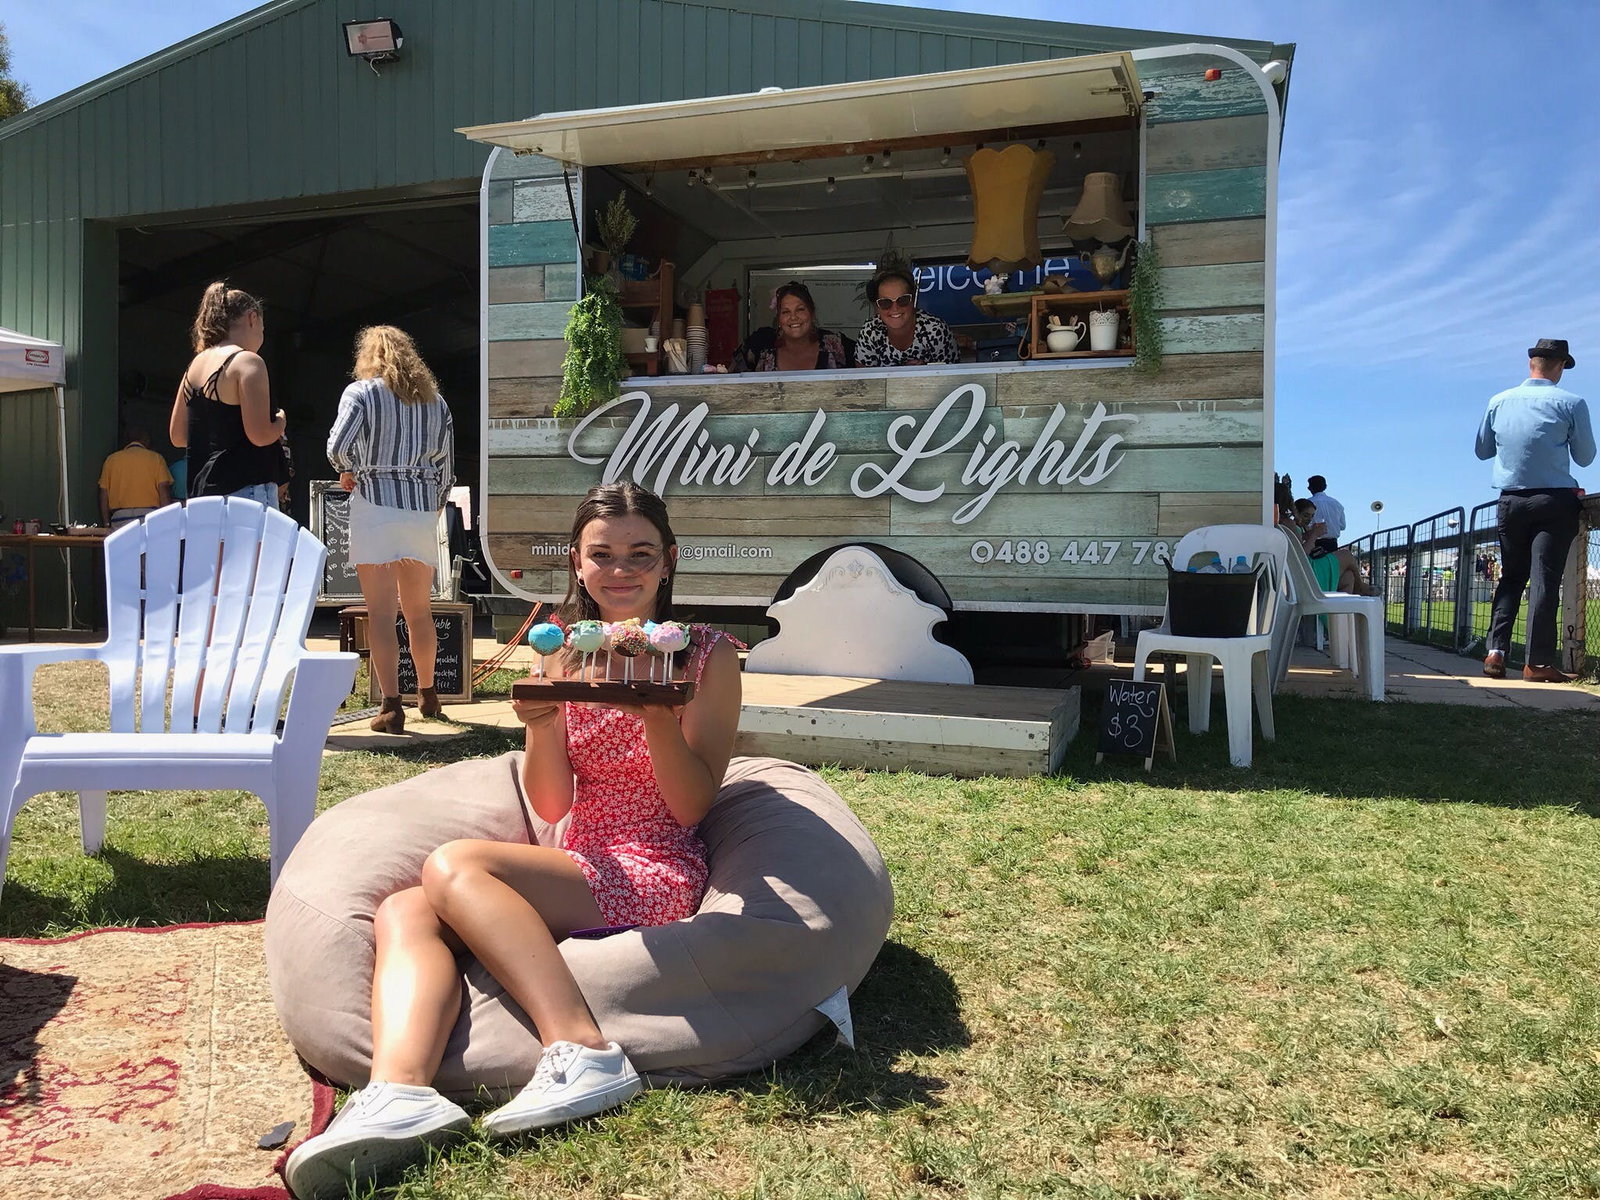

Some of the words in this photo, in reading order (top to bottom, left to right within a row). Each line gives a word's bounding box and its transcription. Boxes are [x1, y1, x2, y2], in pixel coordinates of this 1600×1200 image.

[912, 257, 1070, 293] elce
[568, 390, 759, 499] Mini
[767, 407, 839, 487] de
[850, 383, 1138, 525] Lights
[531, 542, 571, 556] minid
[970, 540, 1050, 564] 0488
[1060, 541, 1122, 565] 447
[1132, 541, 1179, 565] 78
[1109, 682, 1156, 706] Water
